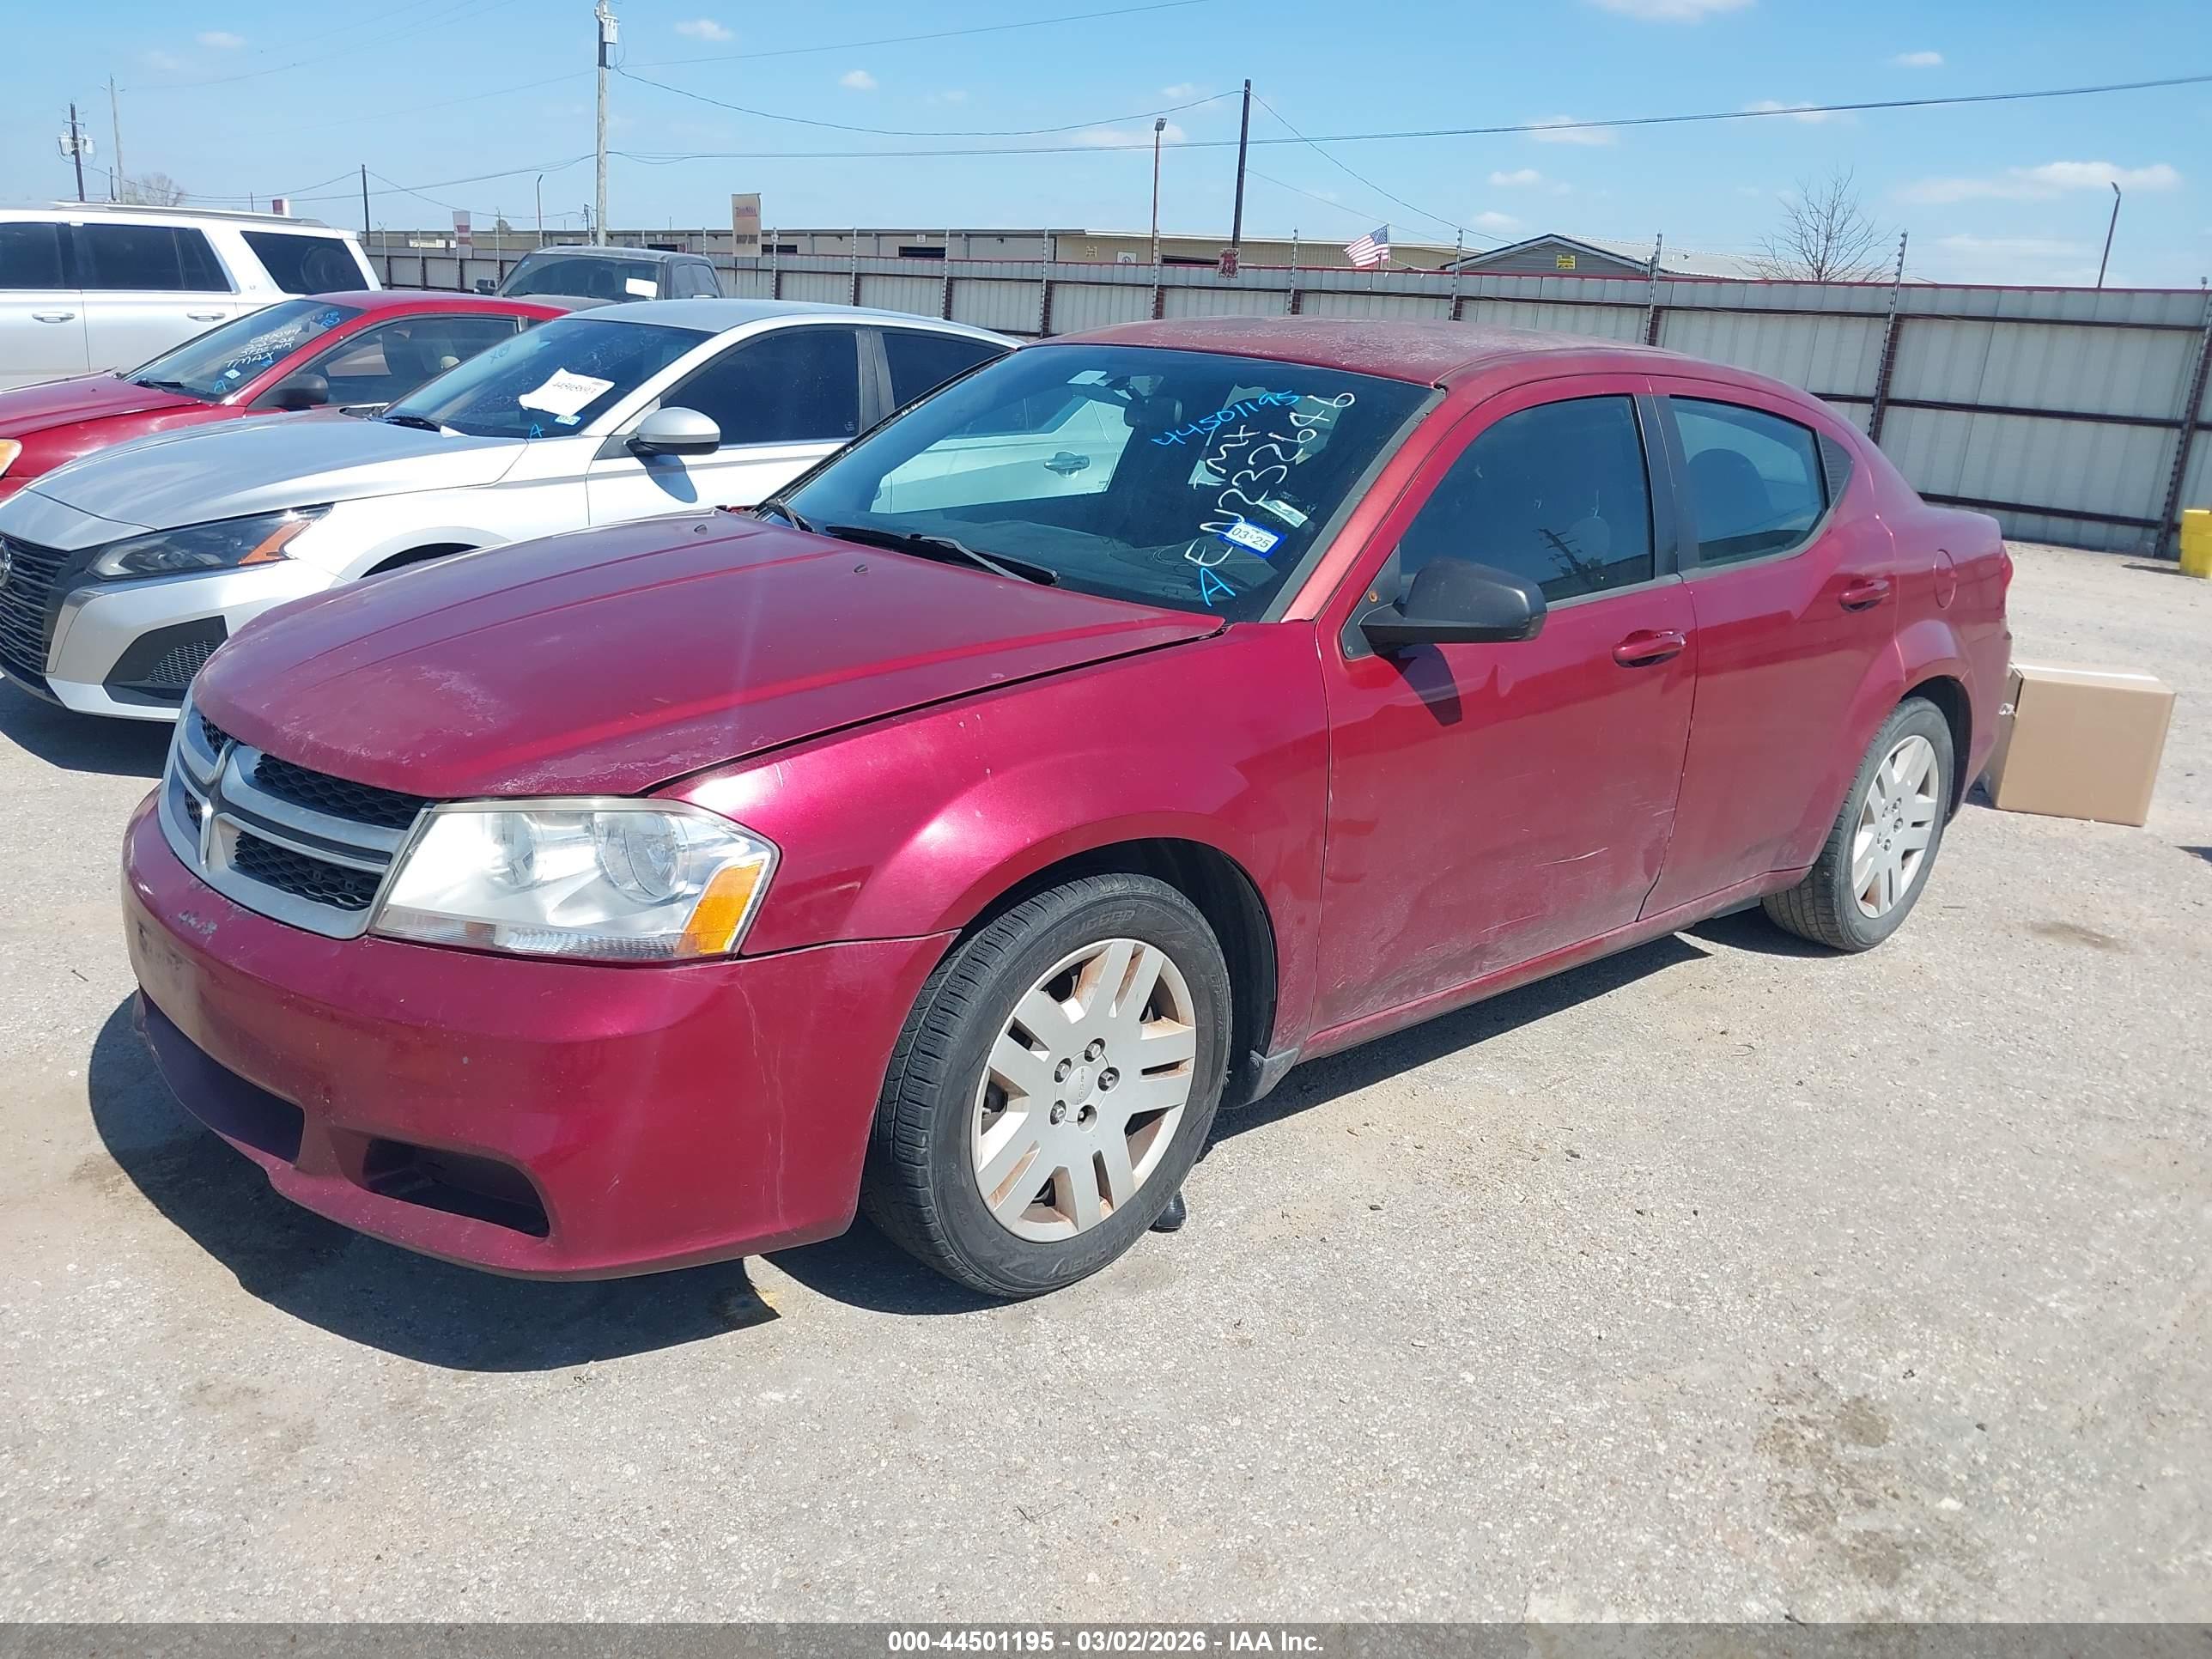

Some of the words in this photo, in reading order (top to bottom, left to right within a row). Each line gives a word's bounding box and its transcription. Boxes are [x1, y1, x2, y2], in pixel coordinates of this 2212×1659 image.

[529, 423, 544, 440] A
[1151, 390, 1299, 446] 44501195
[1200, 567, 1237, 607] A
